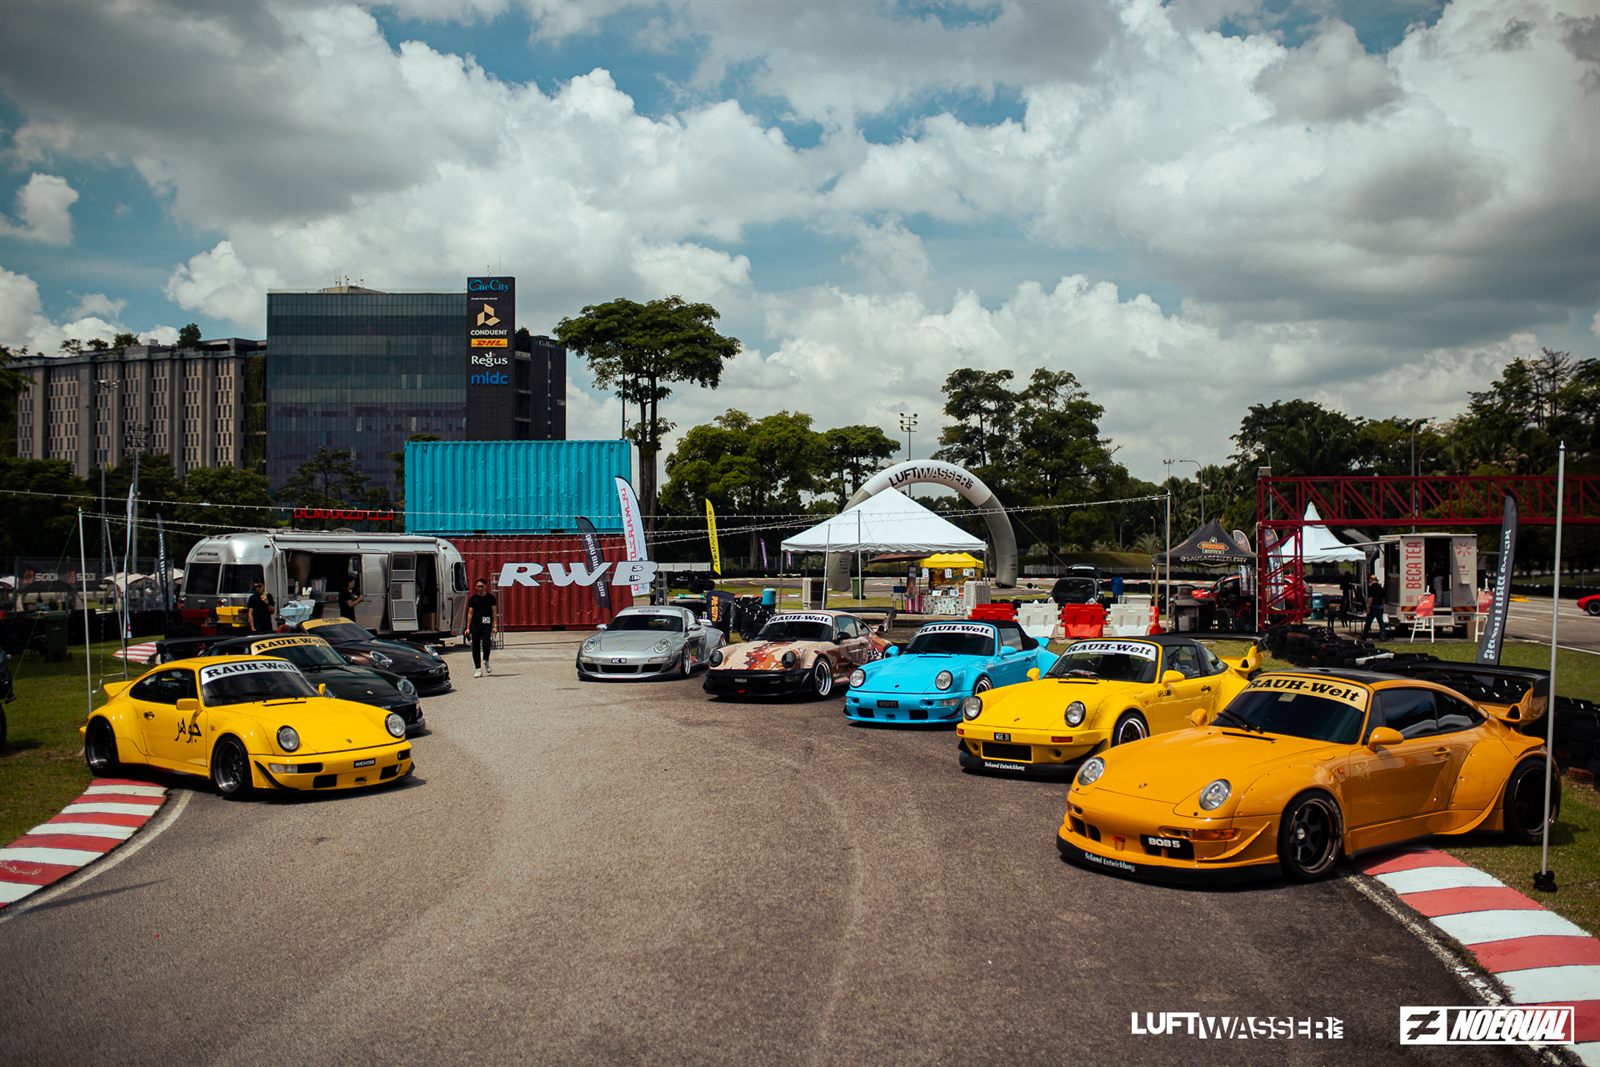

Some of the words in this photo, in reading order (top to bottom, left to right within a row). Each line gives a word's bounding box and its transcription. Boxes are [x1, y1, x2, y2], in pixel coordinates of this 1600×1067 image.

[471, 355, 508, 367] Regus
[471, 371, 508, 385] mldc
[1405, 541, 1422, 560] TEA
[498, 560, 659, 587] RWB
[1405, 562, 1422, 589] BECA
[920, 625, 990, 634] RAUH-Welt
[1066, 643, 1152, 655] RAUH-Welt
[206, 661, 296, 678] RAUH-Welt
[1249, 677, 1361, 702] RAUH-Welt
[1172, 840, 1181, 848] 5
